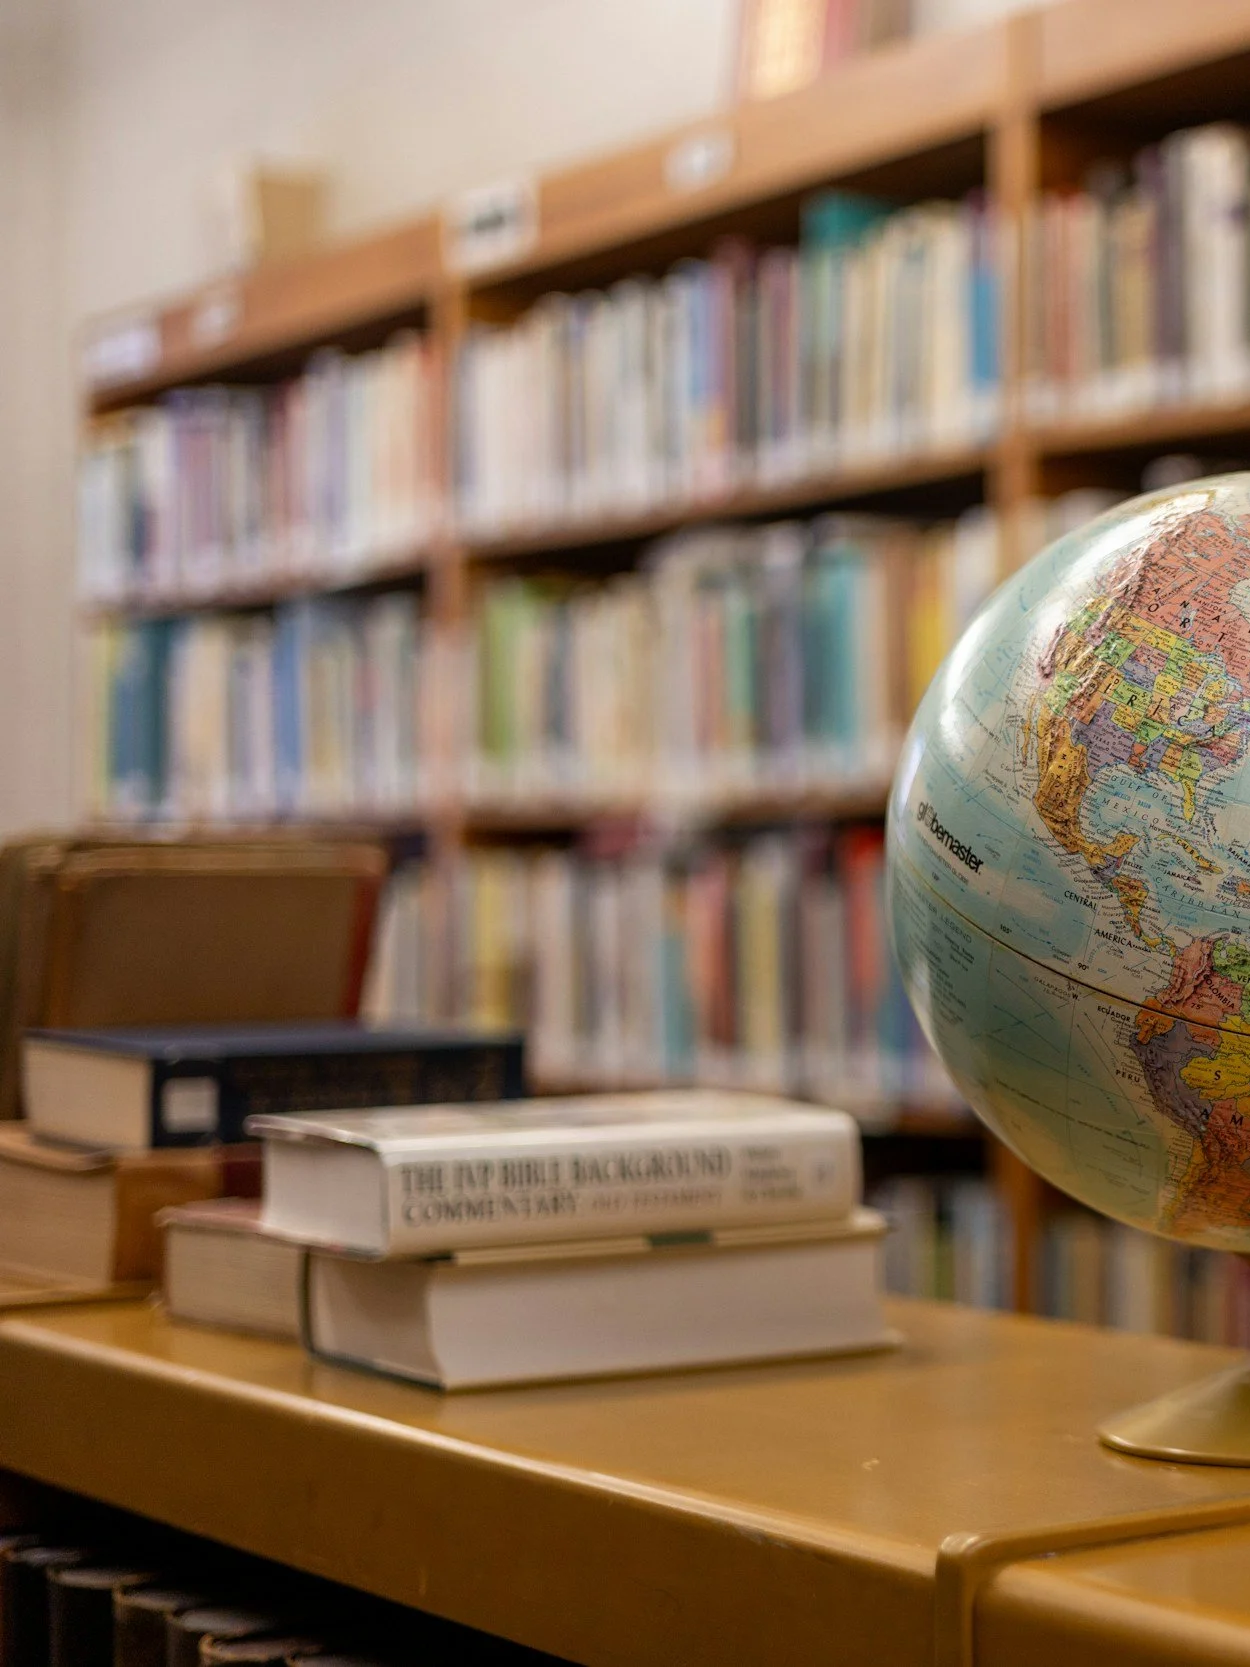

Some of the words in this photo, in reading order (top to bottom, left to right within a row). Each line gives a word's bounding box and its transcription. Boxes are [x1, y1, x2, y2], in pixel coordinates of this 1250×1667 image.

[1193, 597, 1228, 614] MANITOBA
[1111, 775, 1142, 792] GULF
[1152, 792, 1168, 802] OF
[1102, 798, 1159, 824] MEXICO
[1177, 839, 1203, 861] CUBA
[1163, 869, 1191, 881] JAMAICA
[1064, 889, 1098, 911] CENTRAL
[1156, 876, 1240, 919] CARIBBEAN
[1094, 928, 1133, 947] AMERICA
[1203, 974, 1235, 1009] COLOMBIA
[1097, 1005, 1131, 1022] ECUADOR
[1116, 1069, 1141, 1083] PERU
[400, 1164, 443, 1194] THE
[402, 1189, 577, 1227] COMMENTARY
